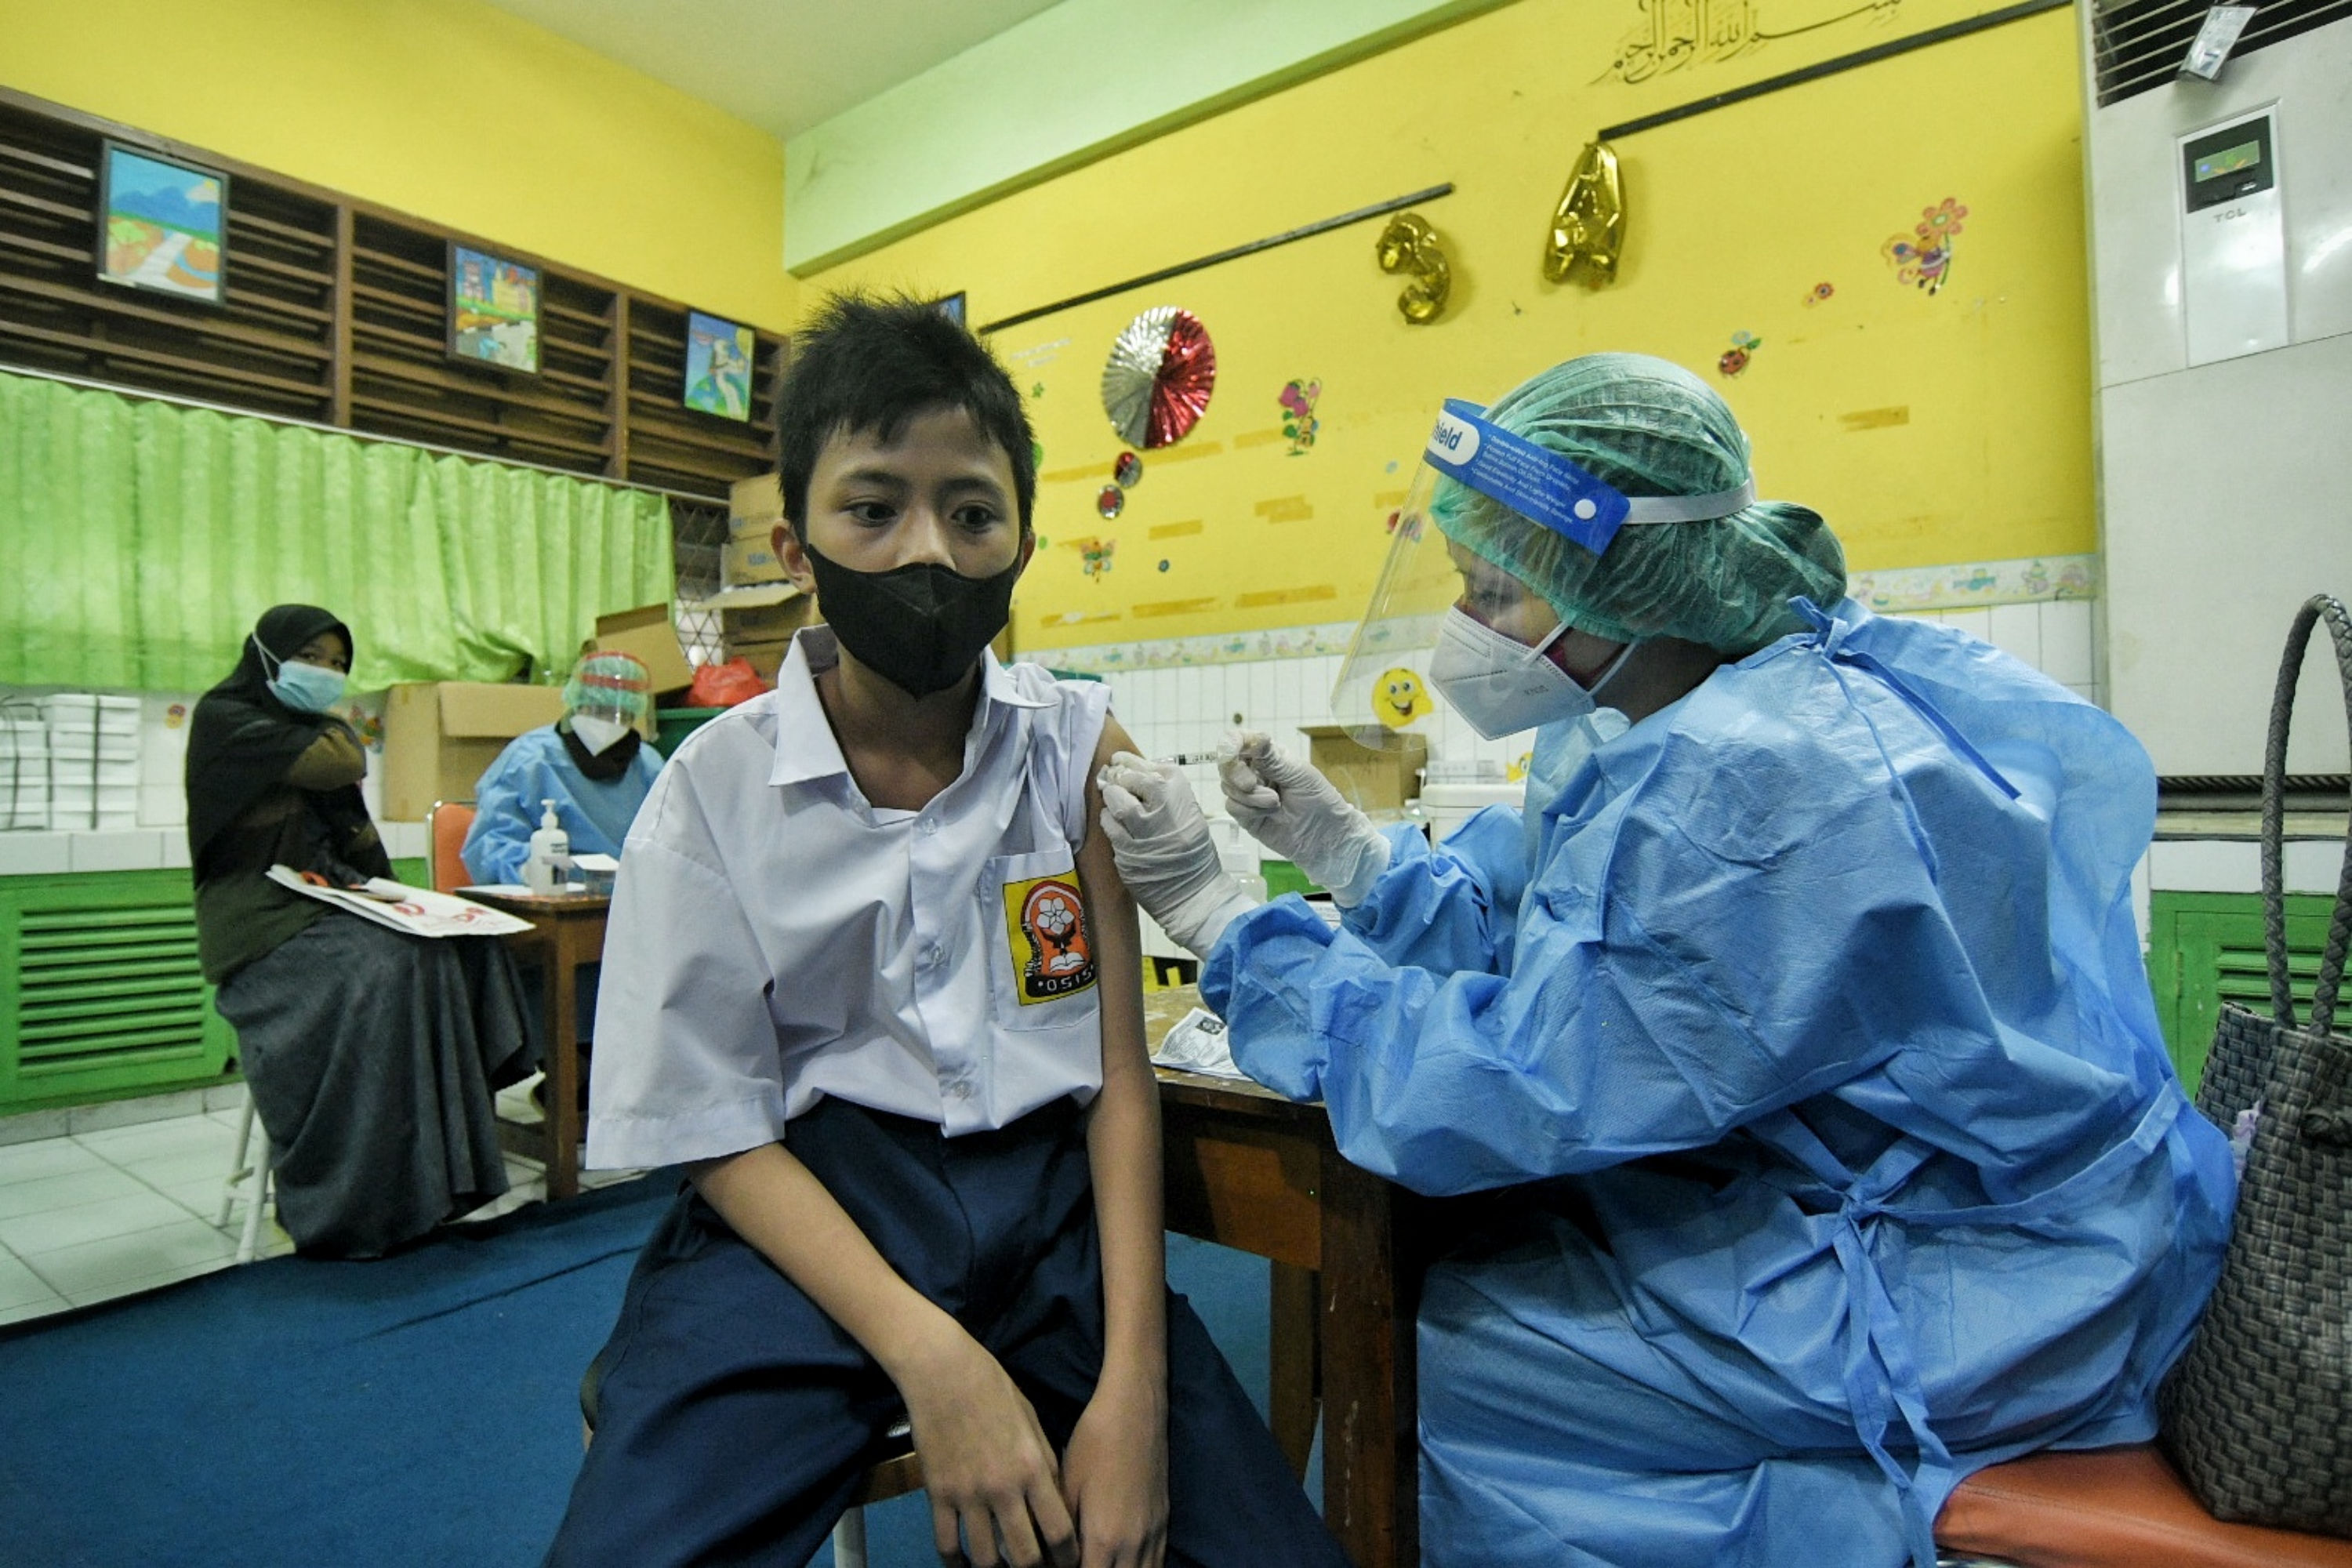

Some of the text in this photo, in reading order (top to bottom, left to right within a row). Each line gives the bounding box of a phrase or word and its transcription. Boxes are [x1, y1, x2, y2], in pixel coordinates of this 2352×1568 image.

[2213, 208, 2247, 223] TCL
[1434, 421, 1463, 451] hield
[1047, 966, 1092, 992] OSIS
